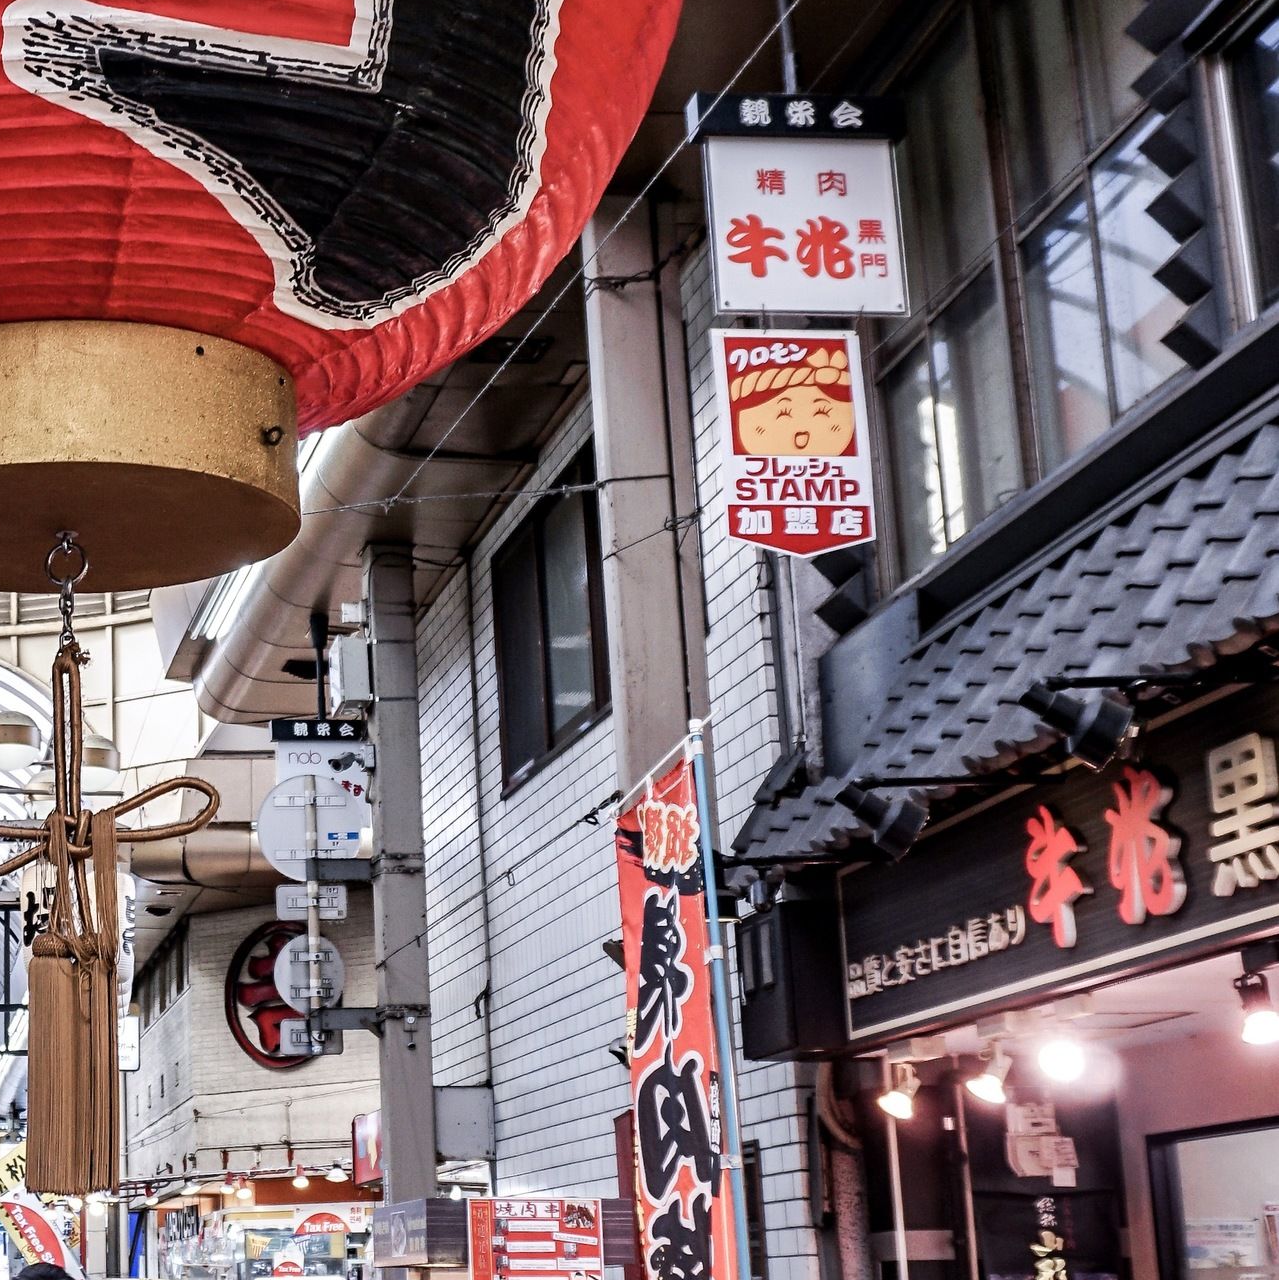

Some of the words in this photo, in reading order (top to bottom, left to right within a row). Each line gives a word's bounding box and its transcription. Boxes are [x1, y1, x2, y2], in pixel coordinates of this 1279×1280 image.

[739, 98, 864, 128] 親栄会
[755, 168, 848, 198] 精肉
[726, 213, 856, 280] 牛兆
[858, 218, 889, 279] 黒門
[729, 341, 809, 372] クロモン
[744, 457, 846, 478] フレッシュ
[735, 477, 861, 503] STAMP
[735, 507, 864, 538] 加盟店
[293, 722, 354, 737] 親栄会
[11, 1204, 28, 1229] Tax
[24, 1225, 44, 1253] Free
[304, 1222, 322, 1233] Tax
[323, 1221, 344, 1232] Free
